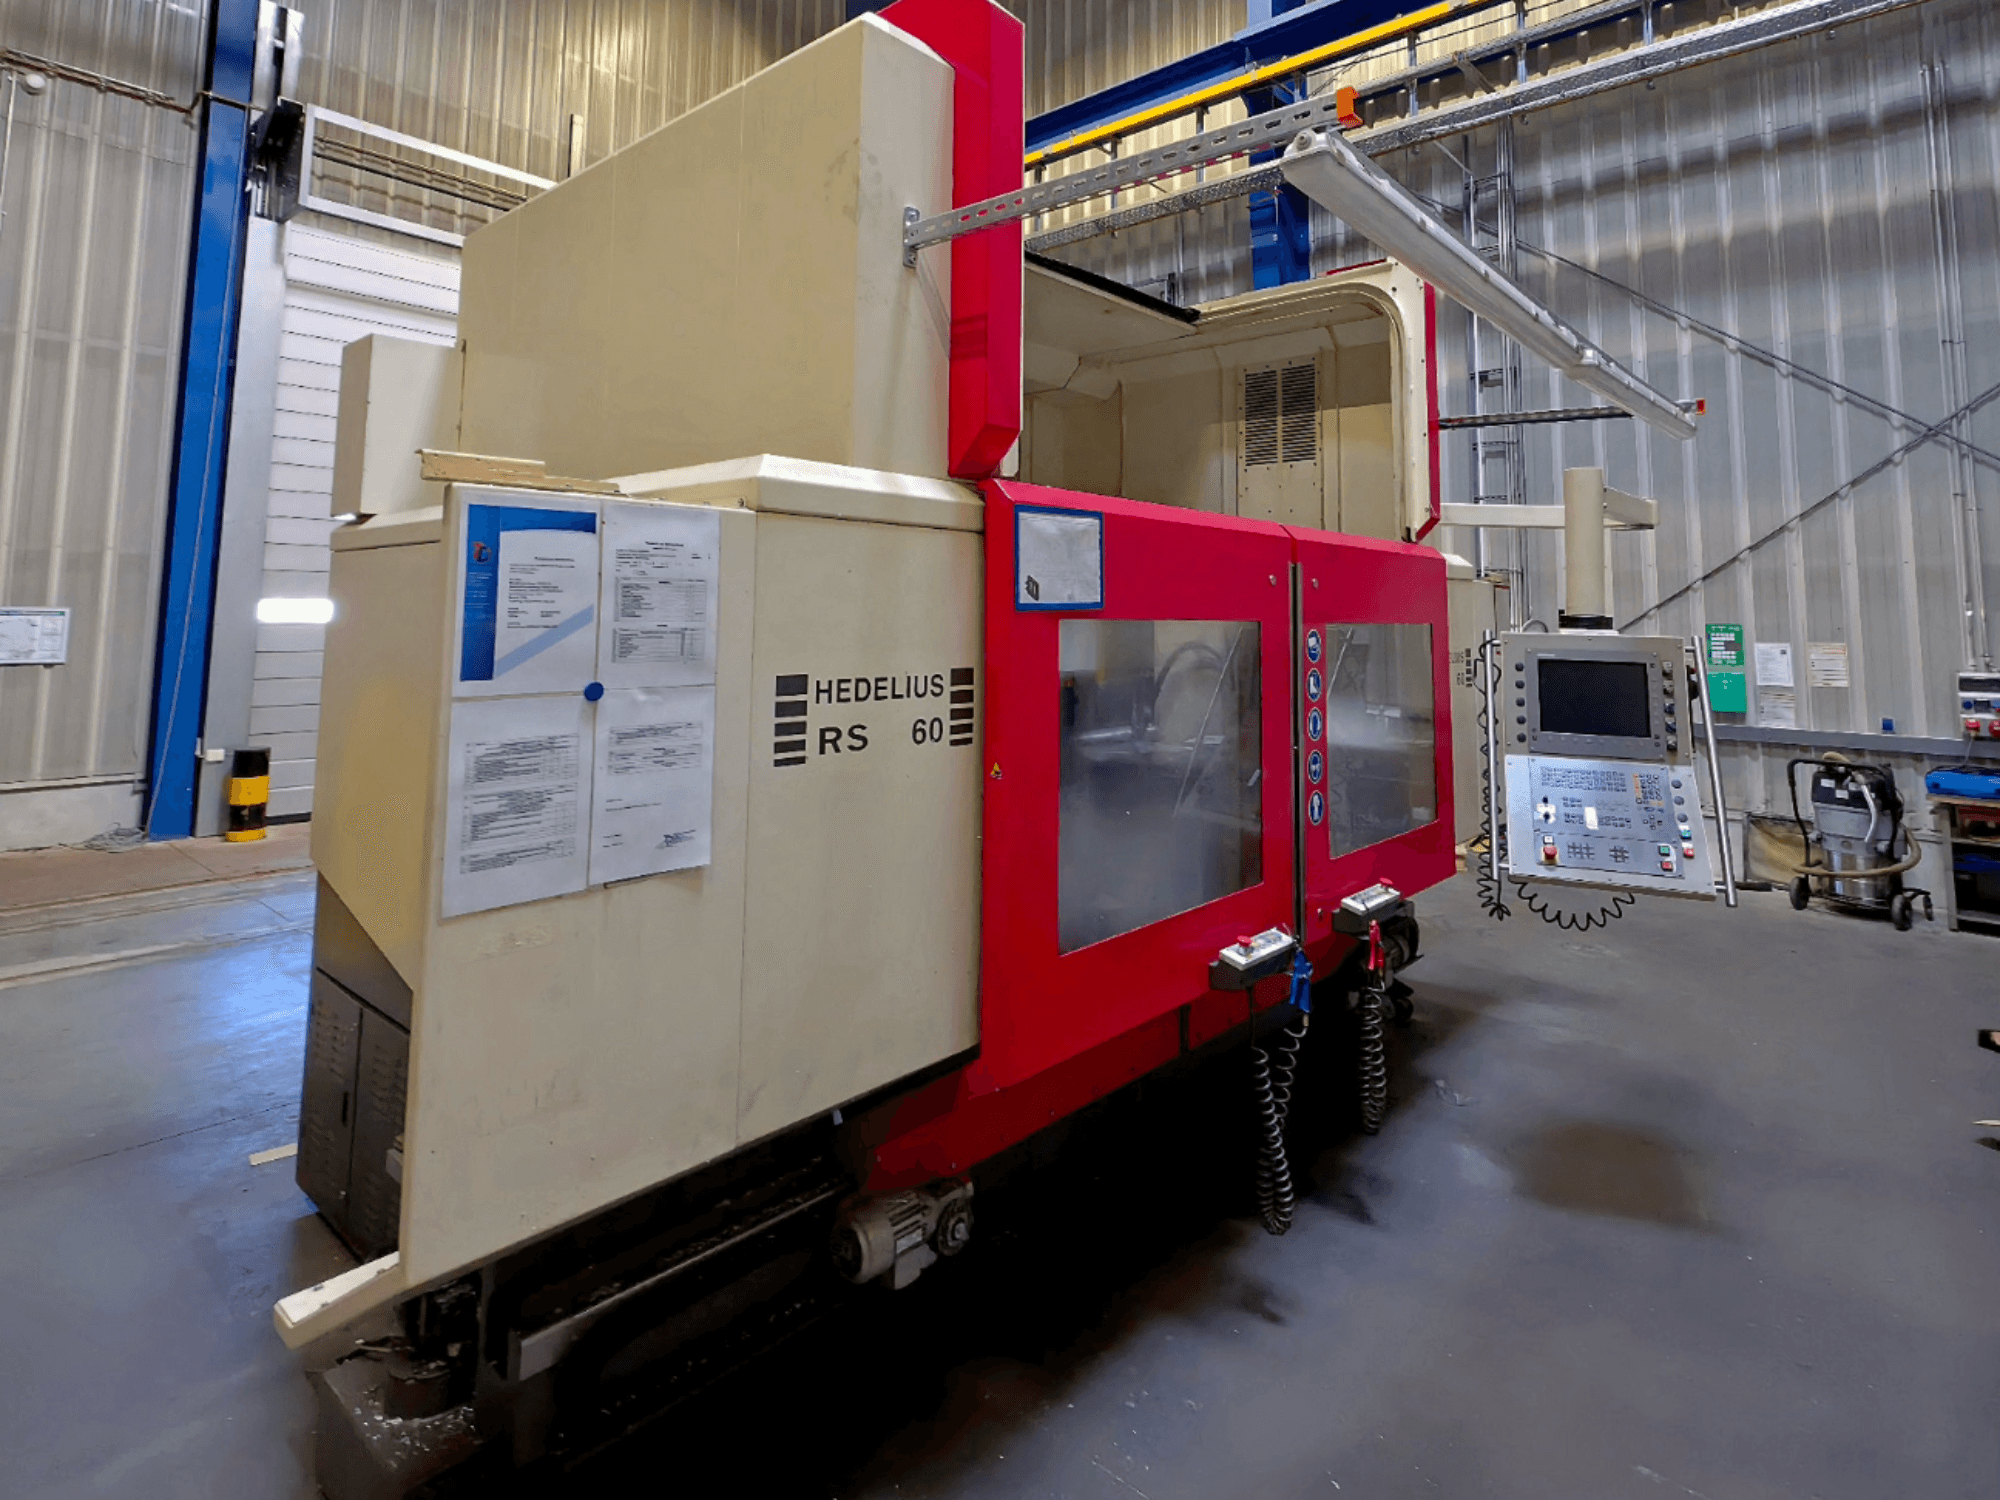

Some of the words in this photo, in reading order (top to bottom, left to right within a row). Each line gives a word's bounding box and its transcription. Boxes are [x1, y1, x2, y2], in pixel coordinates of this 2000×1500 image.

[815, 673, 944, 705] HEDELIUS
[818, 723, 869, 755] RS
[911, 716, 944, 746] 60
